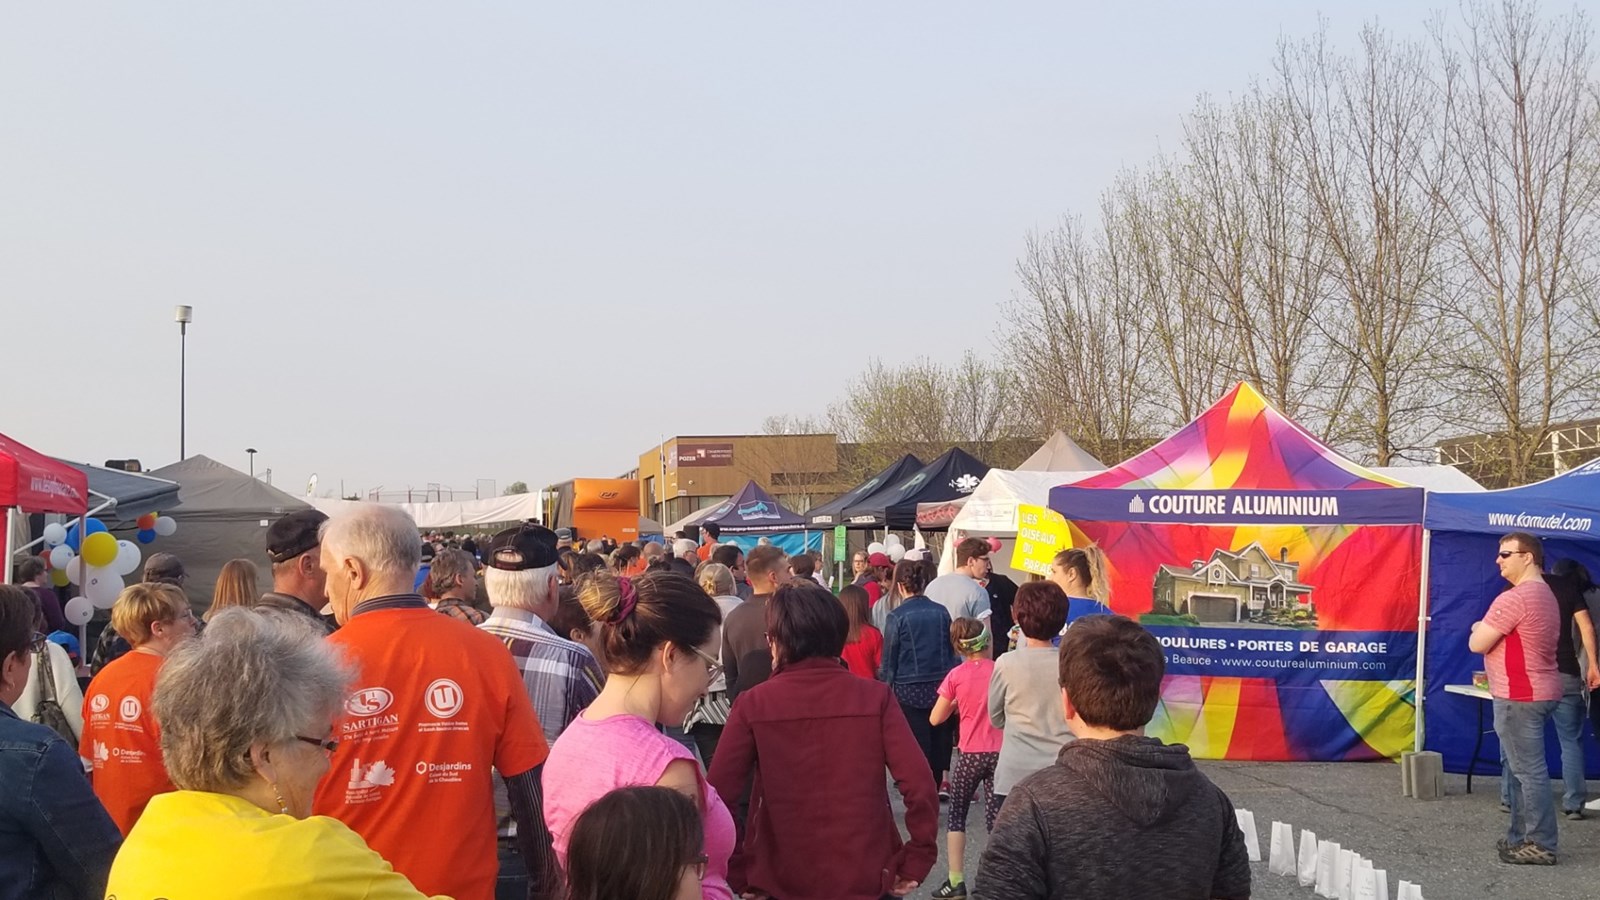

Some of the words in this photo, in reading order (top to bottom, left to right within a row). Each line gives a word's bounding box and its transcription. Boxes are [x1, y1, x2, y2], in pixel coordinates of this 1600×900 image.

[1149, 495, 1226, 514] COUTURE
[1231, 495, 1339, 516] ALUMINIUM
[1022, 512, 1038, 525] LES
[1488, 511, 1592, 531] www.komutel.com
[1021, 527, 1056, 545] OISEAUX
[1155, 636, 1227, 650] OULURES
[1237, 640, 1294, 652] PORTES
[1299, 641, 1320, 653] DE
[1325, 641, 1388, 654] GARAGE
[1172, 653, 1212, 666] Beauce
[1221, 658, 1386, 670] www.couturealuminium.com
[343, 714, 399, 732] SARTIGAN
[428, 761, 472, 772] Desjardins
